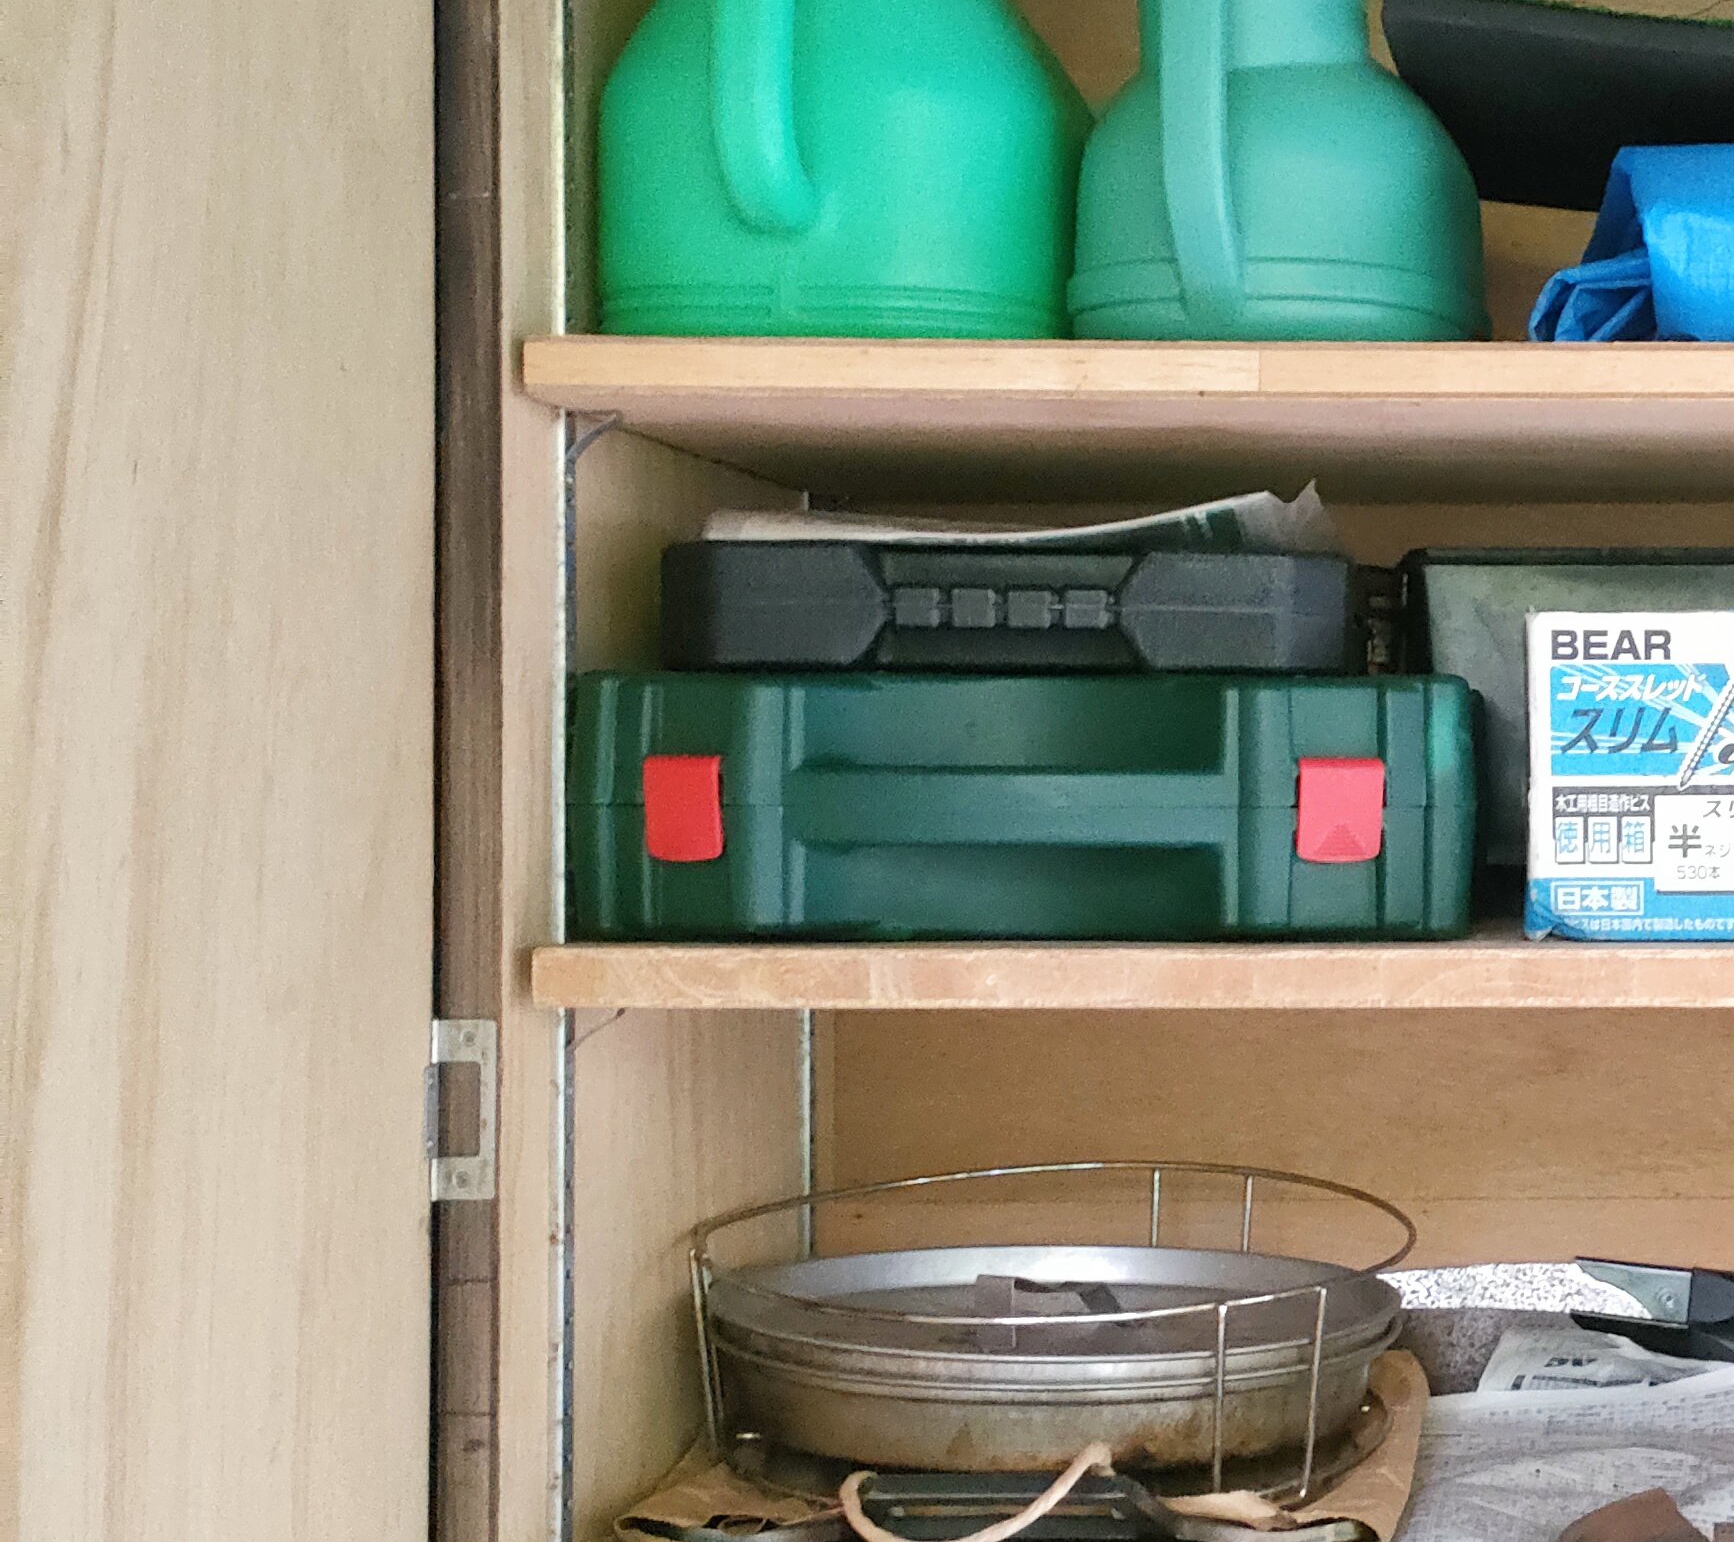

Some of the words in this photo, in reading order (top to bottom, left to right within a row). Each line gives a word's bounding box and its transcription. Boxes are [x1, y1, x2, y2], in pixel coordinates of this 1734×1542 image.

[1550, 629, 1673, 661] BEAR
[1556, 673, 1707, 703] コーススレッド
[1561, 706, 1679, 755] スリム
[1676, 864, 1722, 881] 530本
[1556, 885, 1639, 912] 日本製
